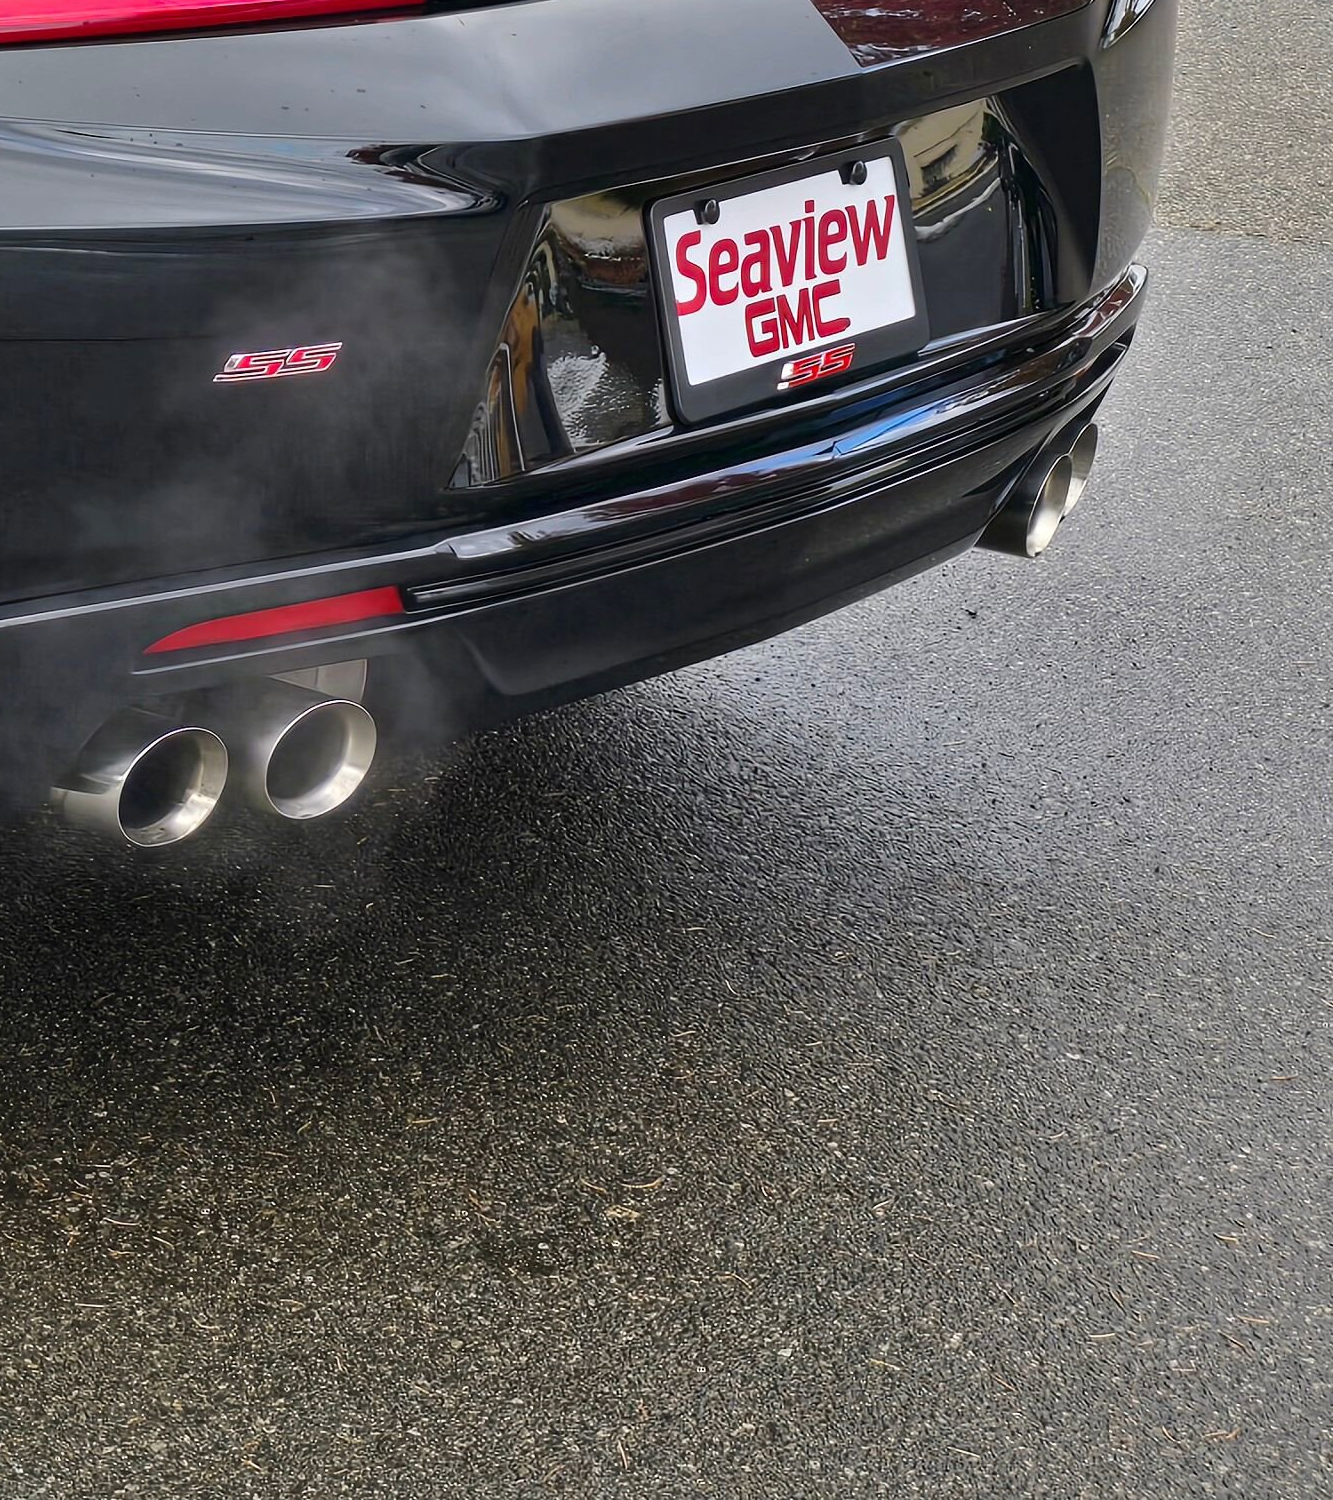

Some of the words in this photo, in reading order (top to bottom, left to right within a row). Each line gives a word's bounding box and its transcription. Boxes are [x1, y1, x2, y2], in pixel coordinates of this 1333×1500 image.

[674, 194, 896, 317] Seaview
[744, 279, 851, 358] GMC
[212, 341, 343, 383] SS
[776, 343, 856, 391] SS
